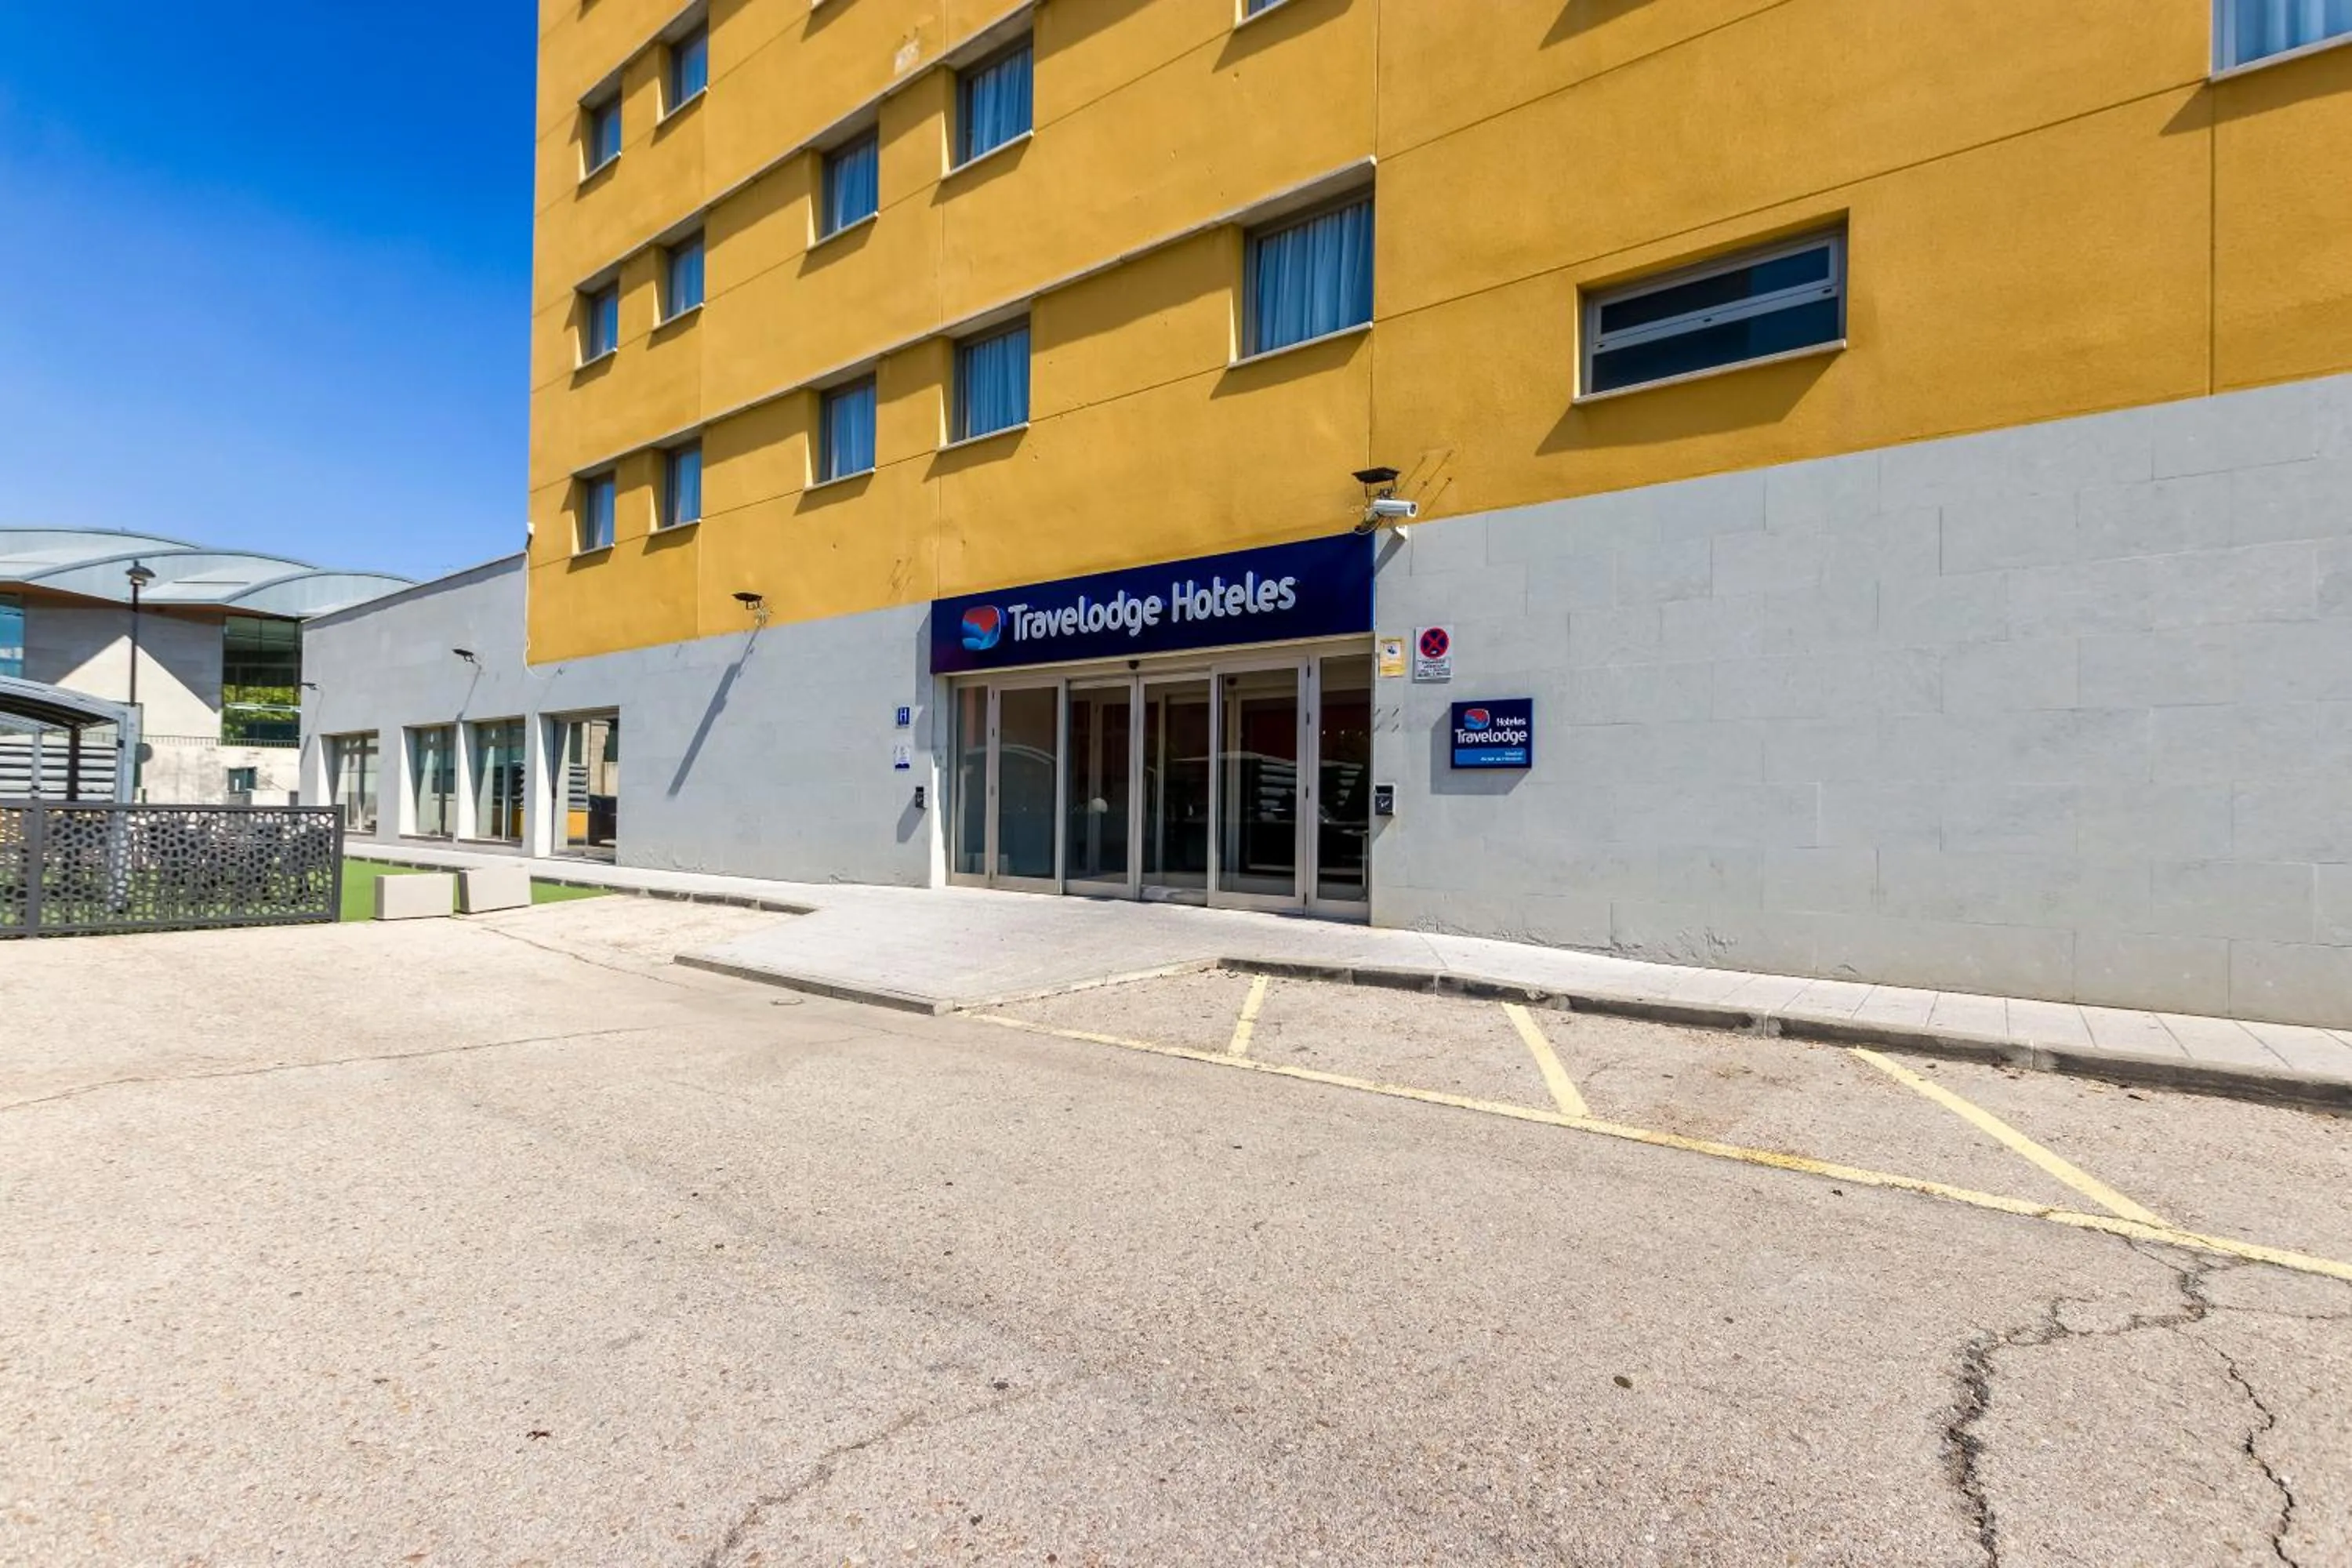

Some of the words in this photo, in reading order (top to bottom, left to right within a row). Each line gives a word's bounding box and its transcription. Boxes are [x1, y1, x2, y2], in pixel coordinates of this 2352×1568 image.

[1007, 590, 1163, 641] Travelodge
[1171, 571, 1297, 623] Hoteles
[899, 708, 907, 722] H
[1455, 728, 1528, 746] Travelodge
